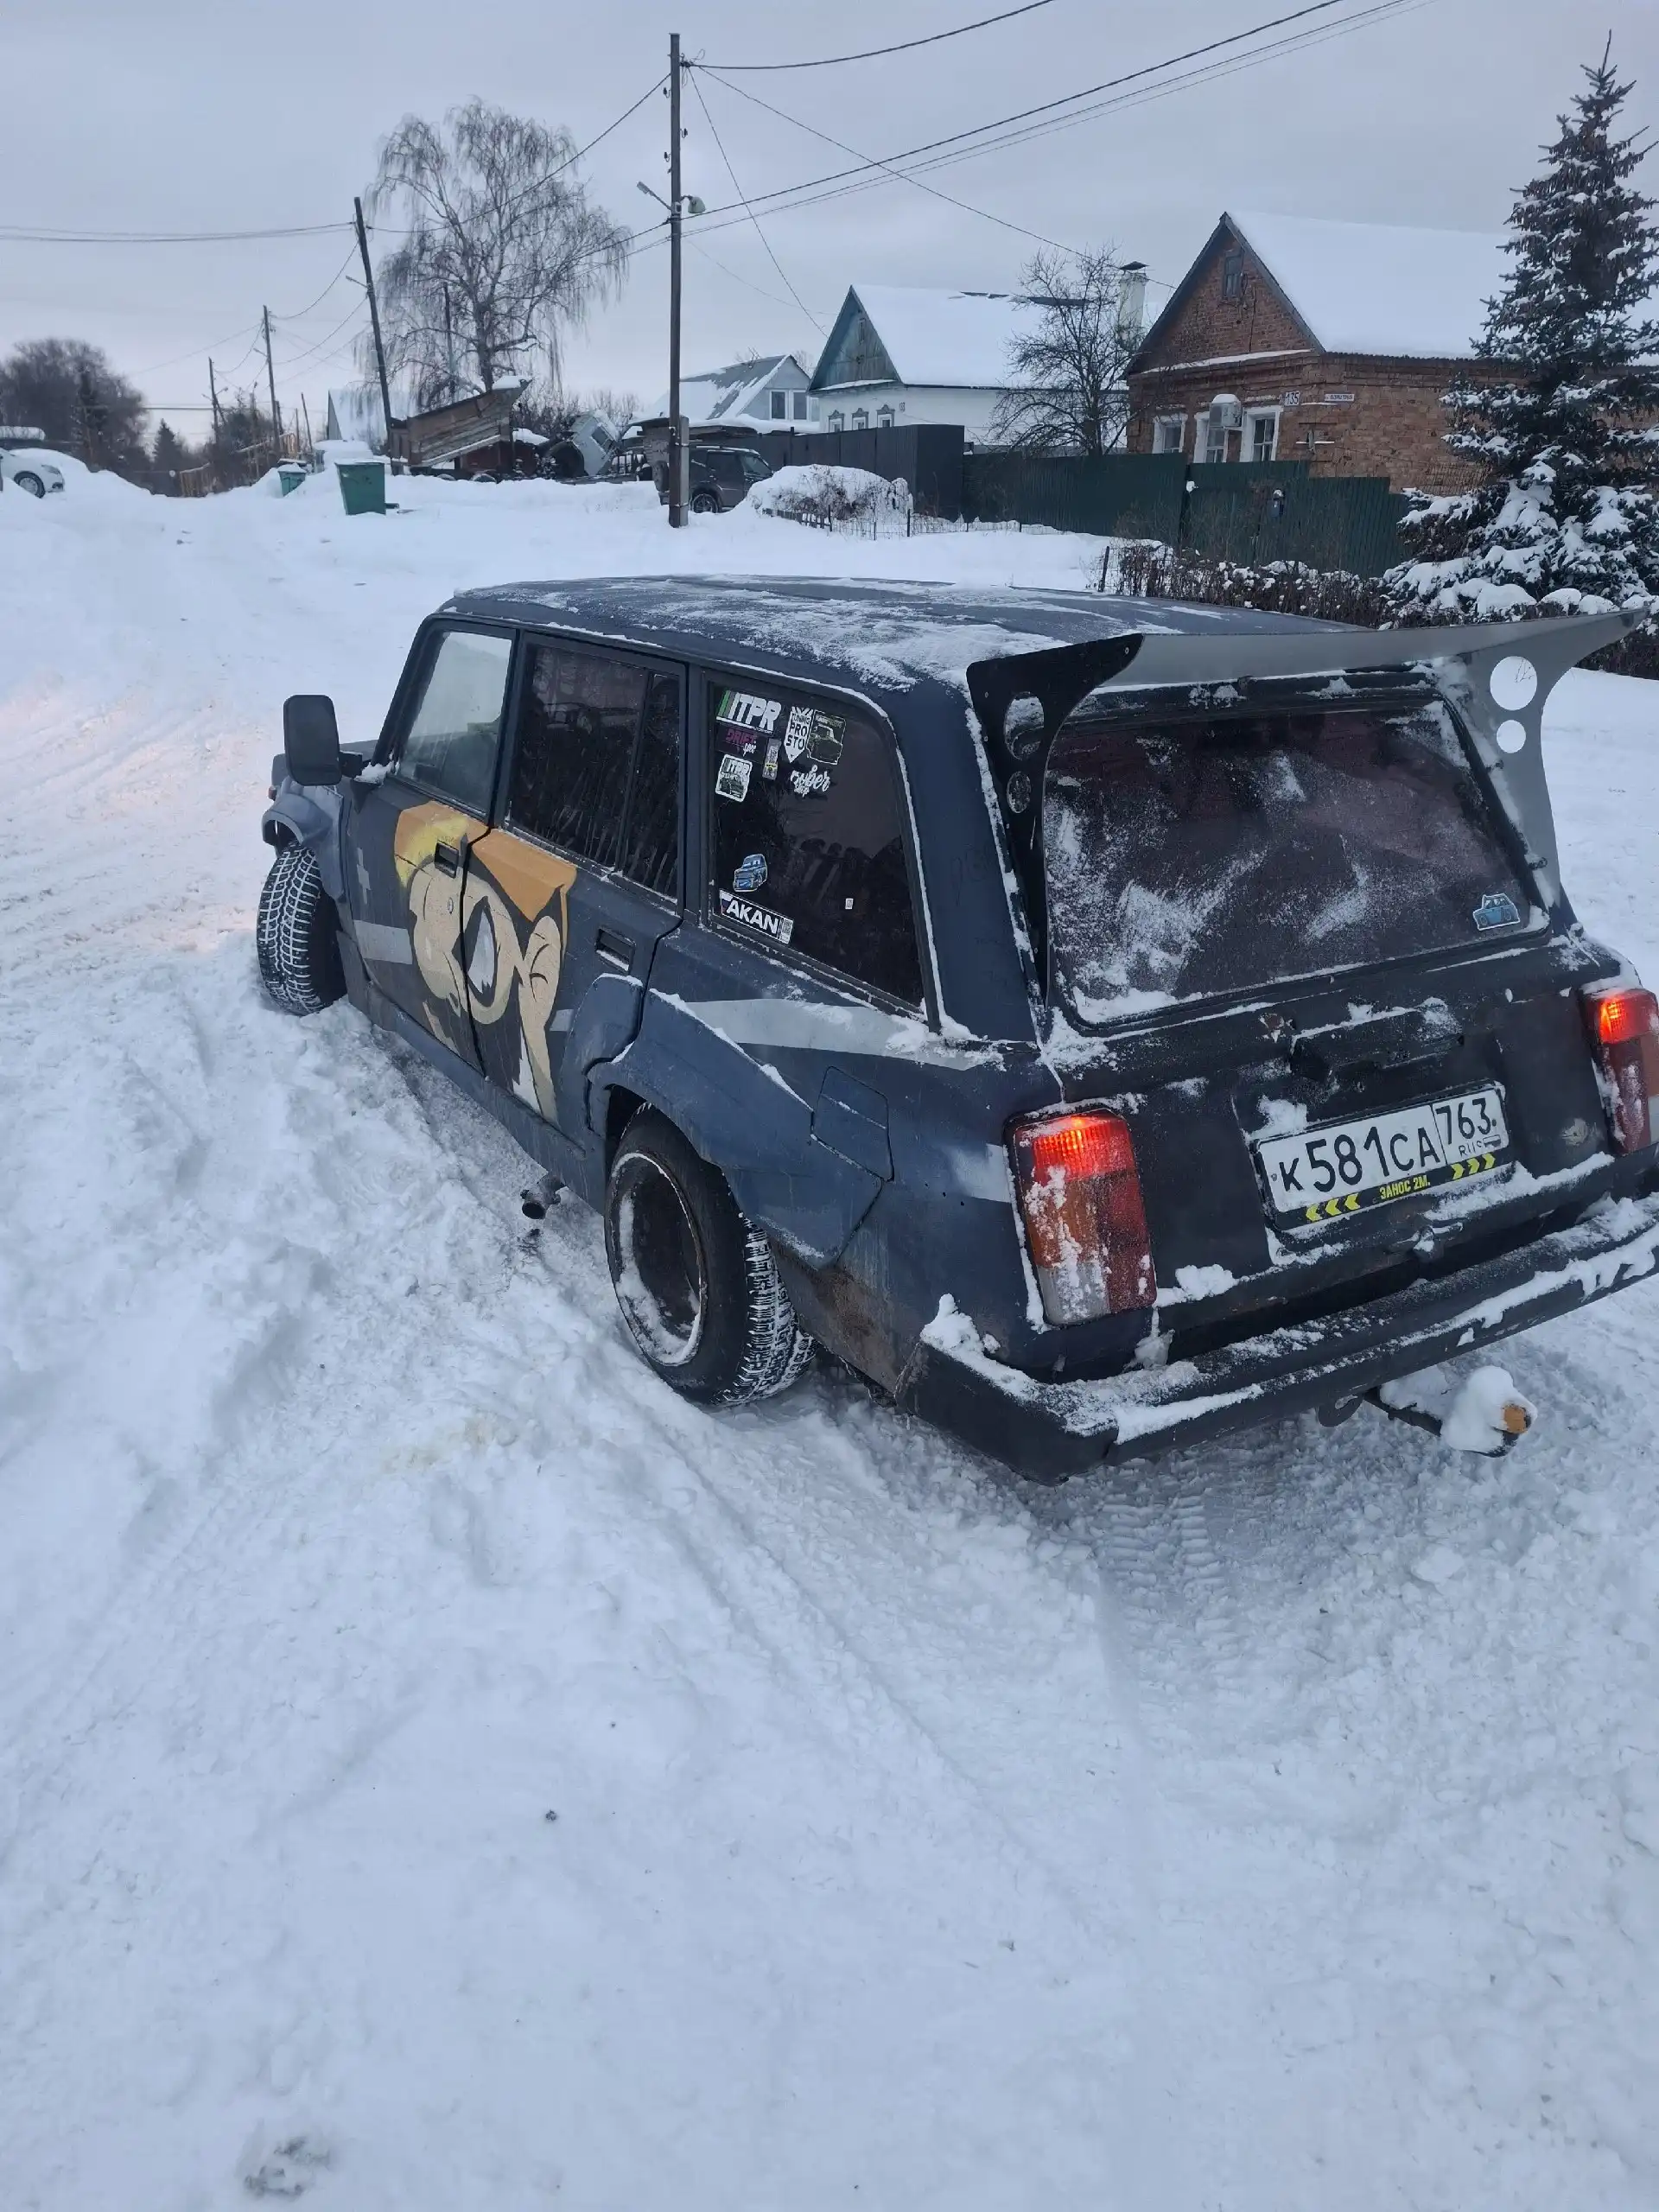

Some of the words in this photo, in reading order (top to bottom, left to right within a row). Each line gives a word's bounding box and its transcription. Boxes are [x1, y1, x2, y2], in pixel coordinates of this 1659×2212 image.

[791, 713, 810, 725] TUNING
[789, 721, 808, 737] PRO
[785, 734, 805, 750] STO
[1279, 1126, 1441, 1193] К581СА
[1435, 1097, 1492, 1145] 763
[1379, 1179, 1410, 1200] ЗАНОС
